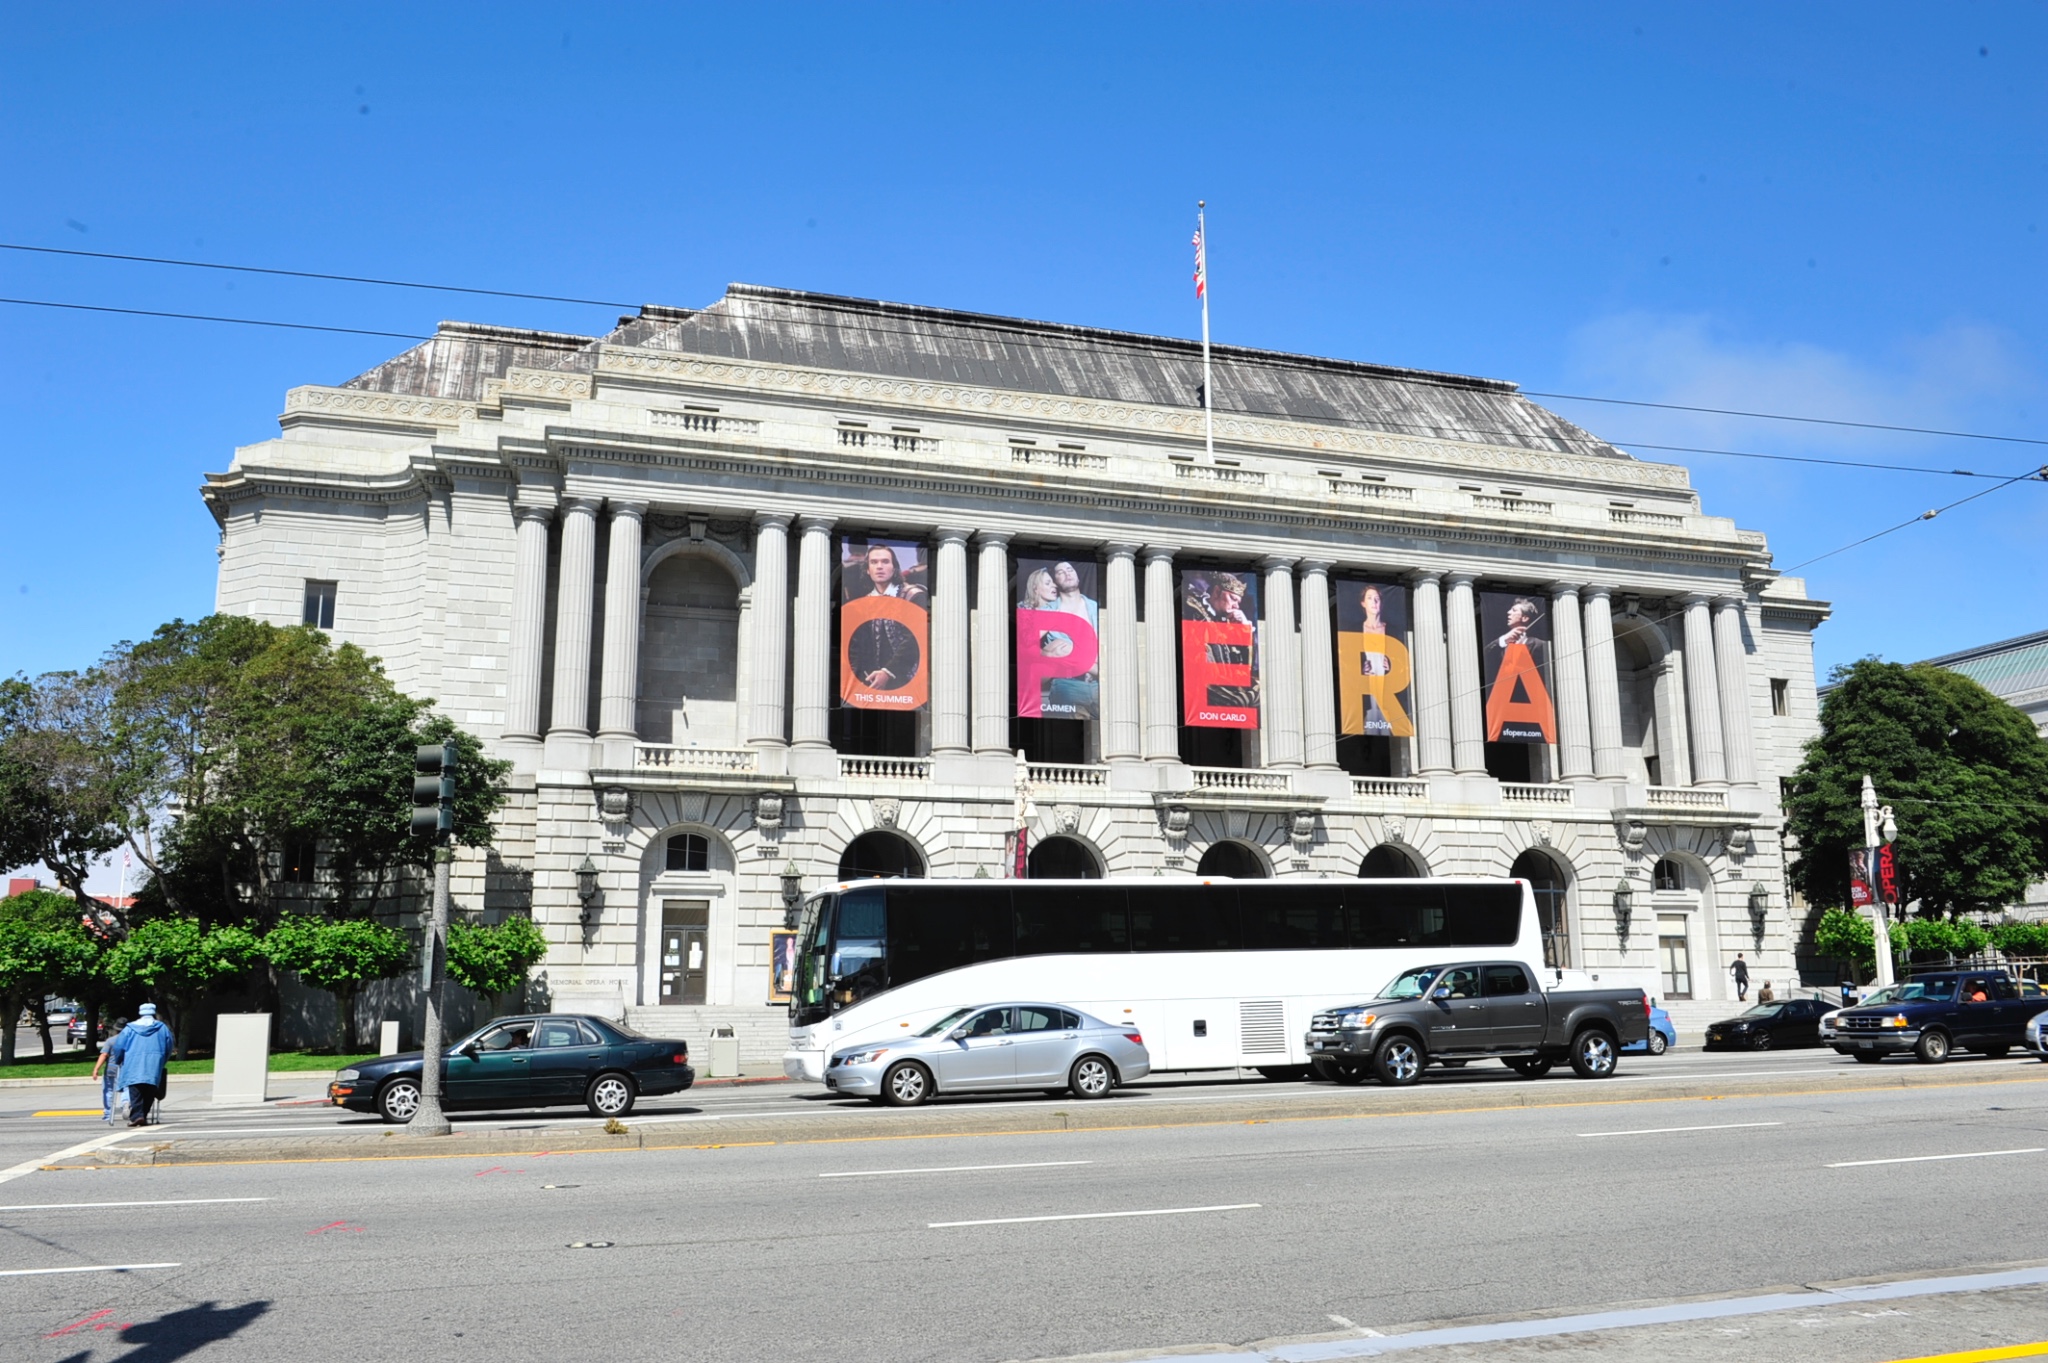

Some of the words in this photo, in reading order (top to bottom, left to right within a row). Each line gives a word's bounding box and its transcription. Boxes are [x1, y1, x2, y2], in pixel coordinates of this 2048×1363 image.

[1016, 608, 1098, 718] P
[1182, 620, 1257, 729] E
[1338, 631, 1414, 737] R
[854, 693, 874, 703] THIS
[875, 694, 913, 705] SUMMER
[1040, 703, 1076, 713] CARMEN
[1199, 711, 1219, 721] DON
[1220, 712, 1247, 722] CARLO
[1485, 643, 1557, 744] A
[1502, 728, 1541, 738] sfopera.com
[1880, 843, 1897, 903] OPERA
